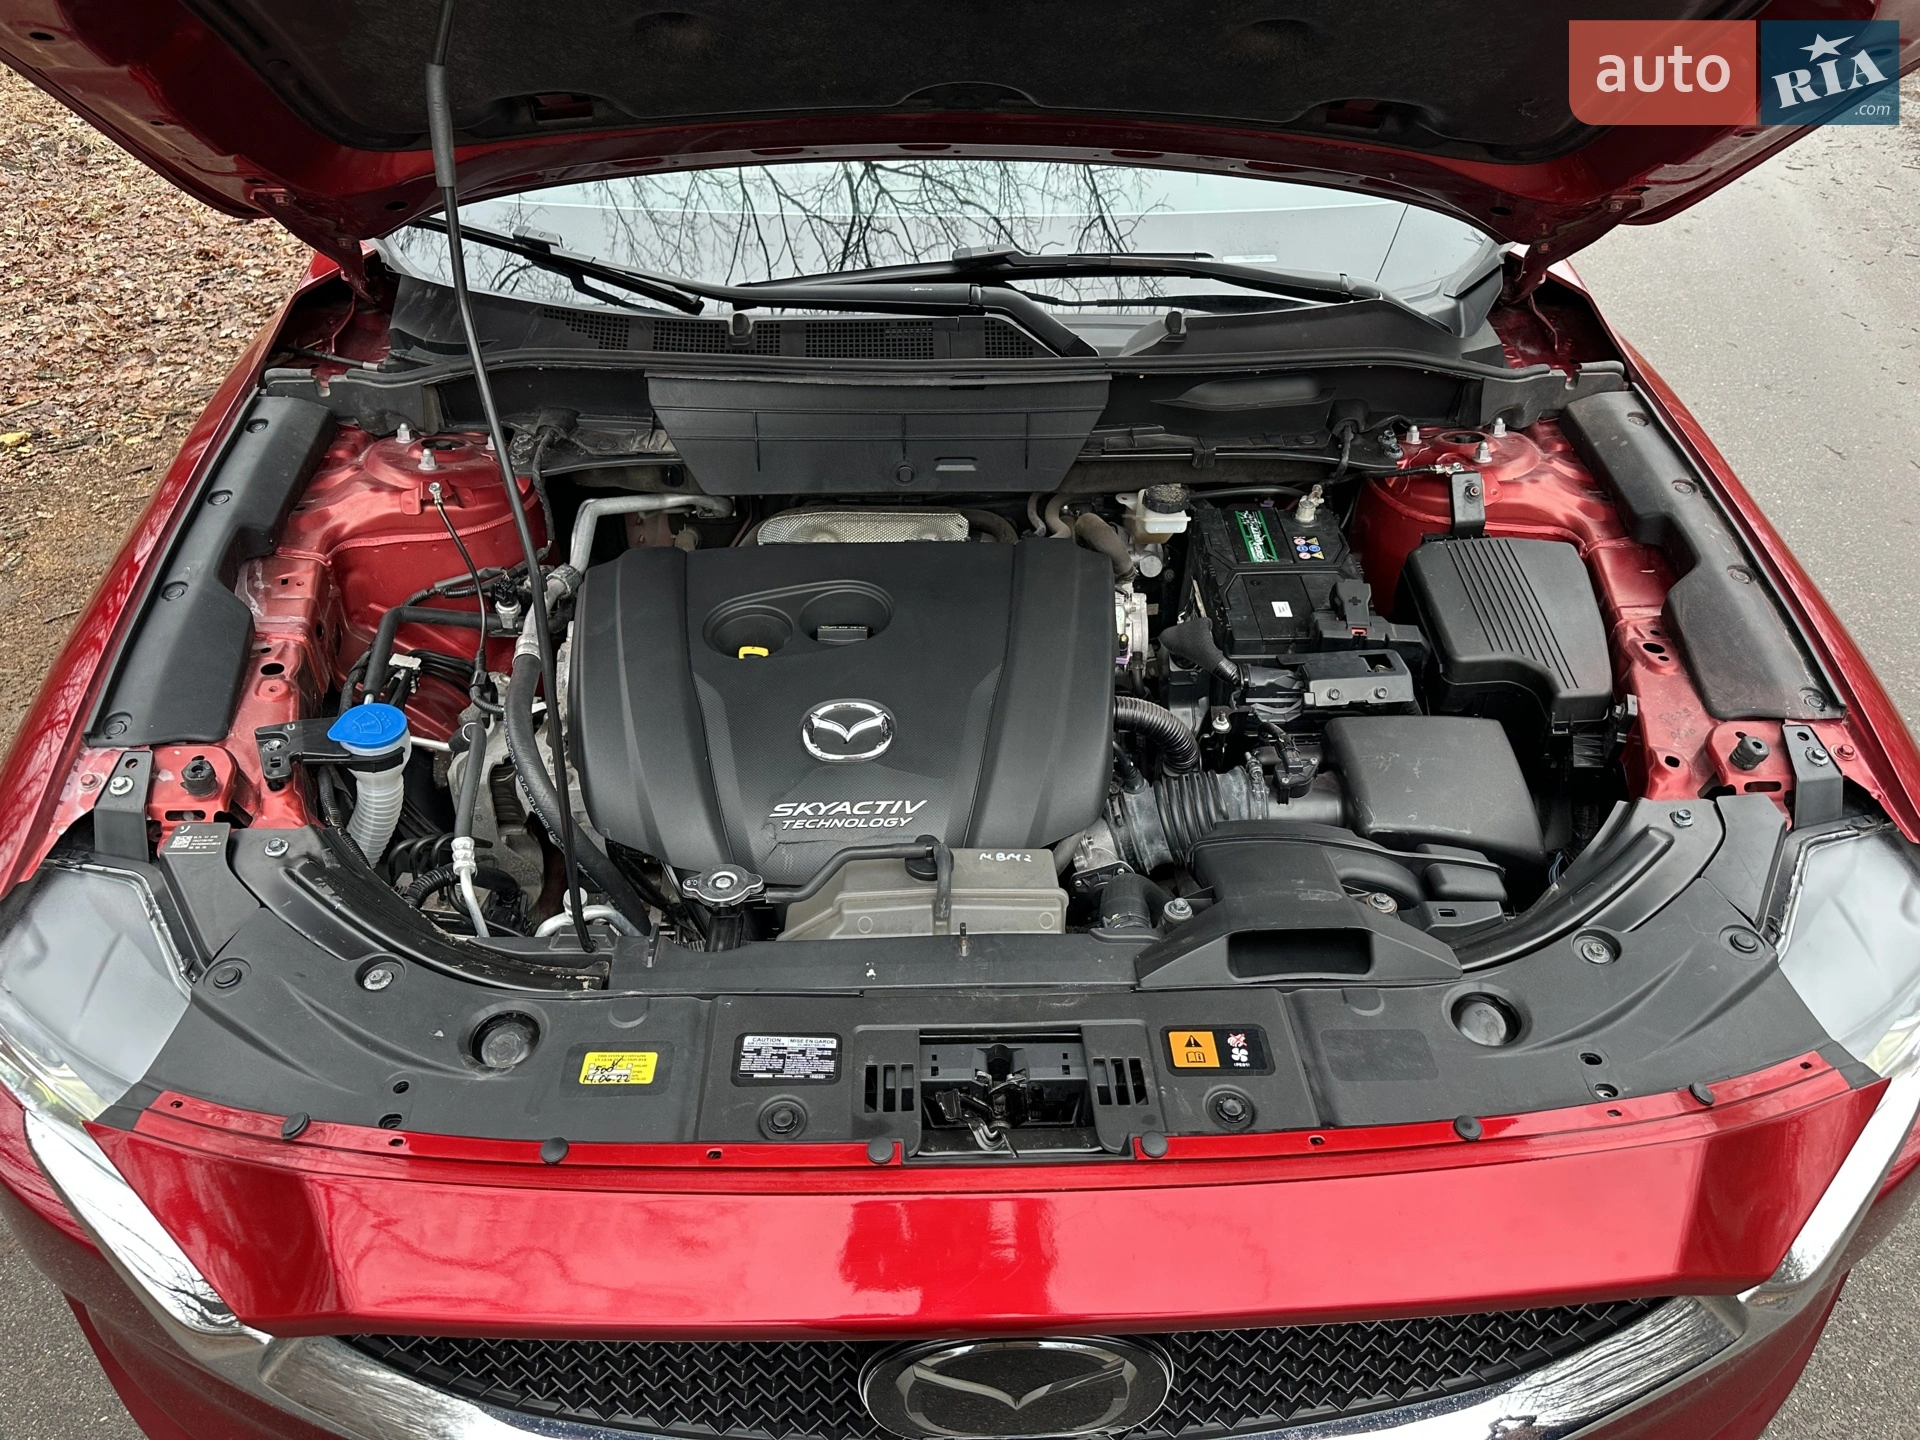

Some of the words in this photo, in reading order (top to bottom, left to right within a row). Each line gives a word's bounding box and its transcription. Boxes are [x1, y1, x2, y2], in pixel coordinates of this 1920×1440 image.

[769, 799, 928, 819] SKYACTIV
[781, 816, 914, 830] TECHNOLOGY
[583, 1074, 631, 1083] 14.06.22
